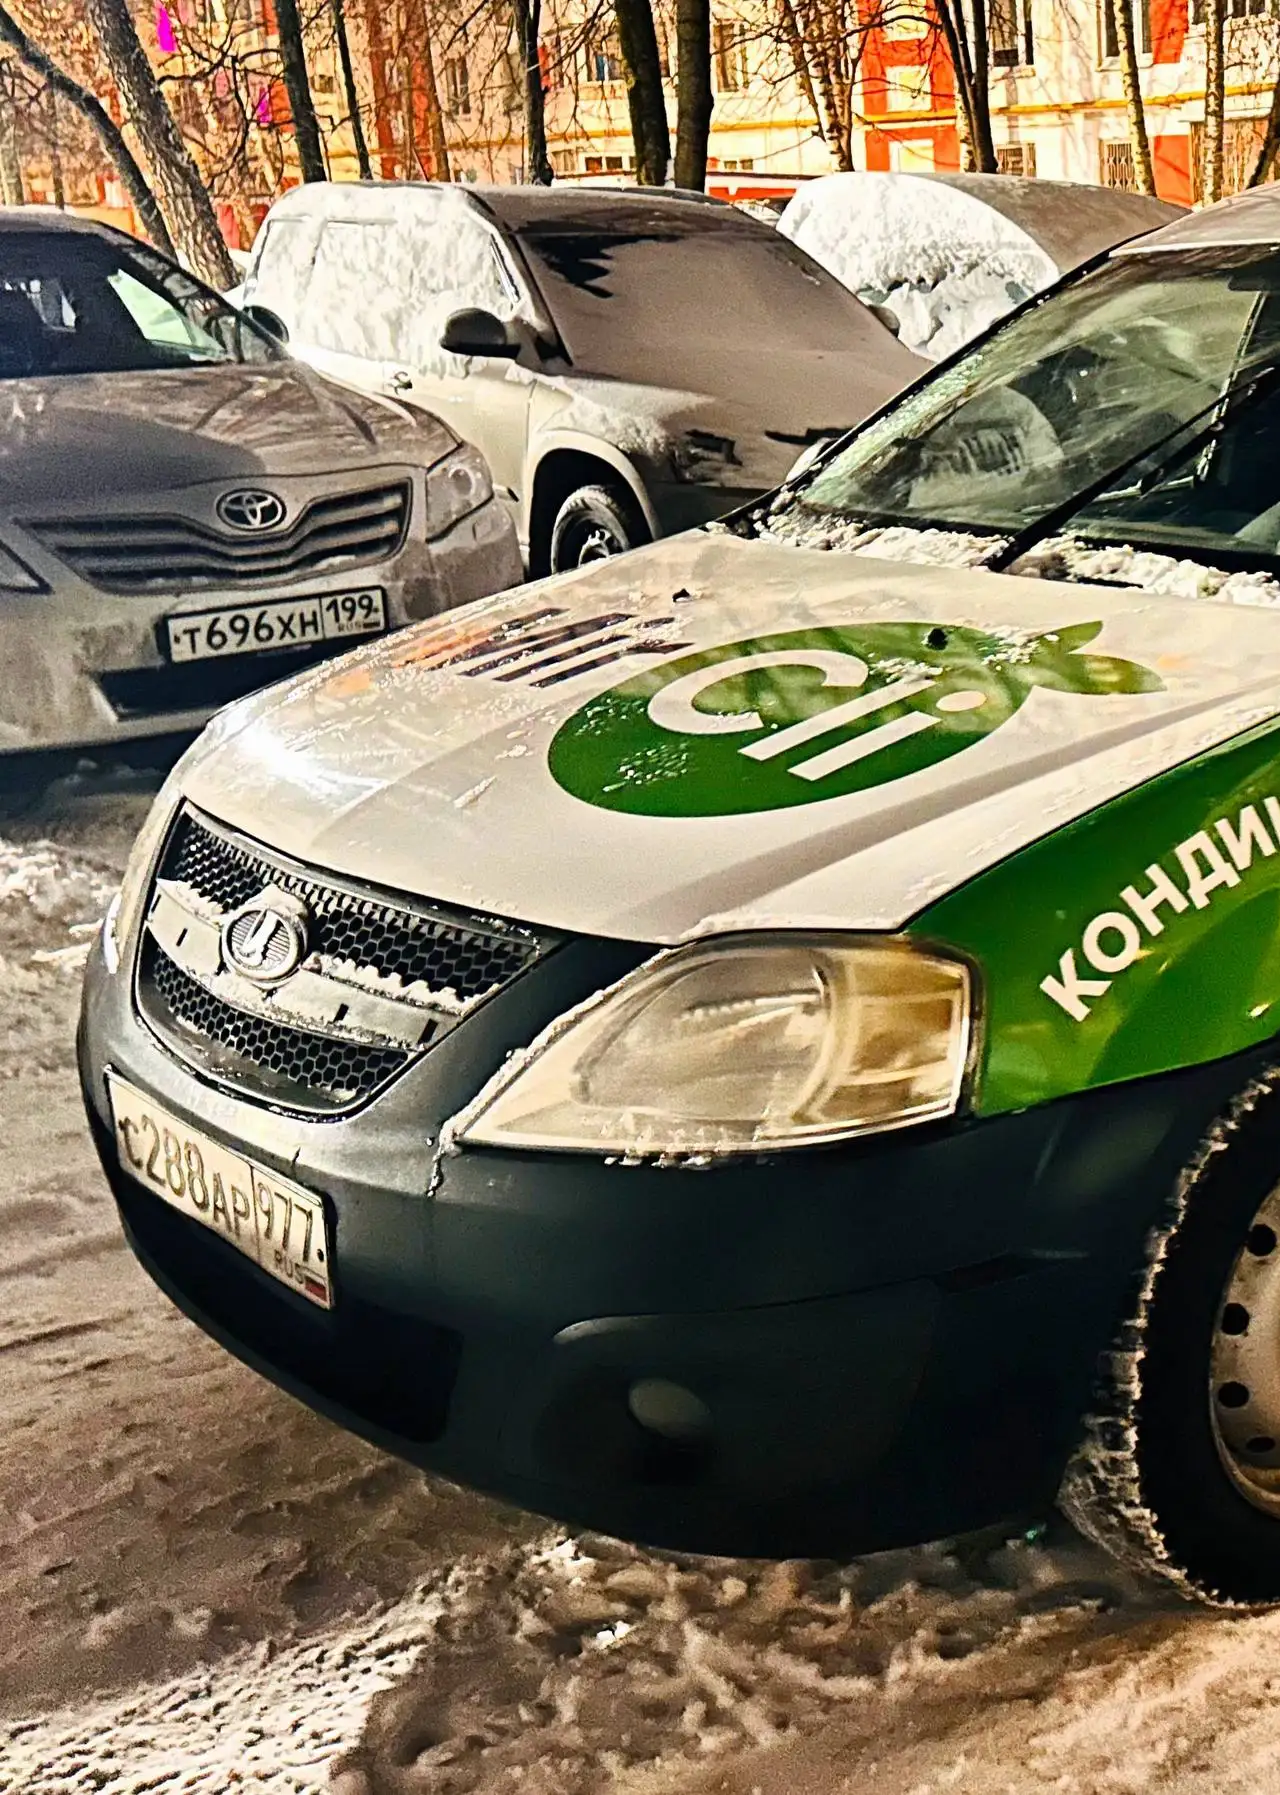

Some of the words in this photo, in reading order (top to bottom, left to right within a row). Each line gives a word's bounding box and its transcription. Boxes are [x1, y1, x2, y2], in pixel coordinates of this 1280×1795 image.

[325, 594, 374, 623] 199
[648, 649, 987, 782] Cli
[258, 1181, 313, 1262] 977
[274, 1249, 305, 1285] RUS
